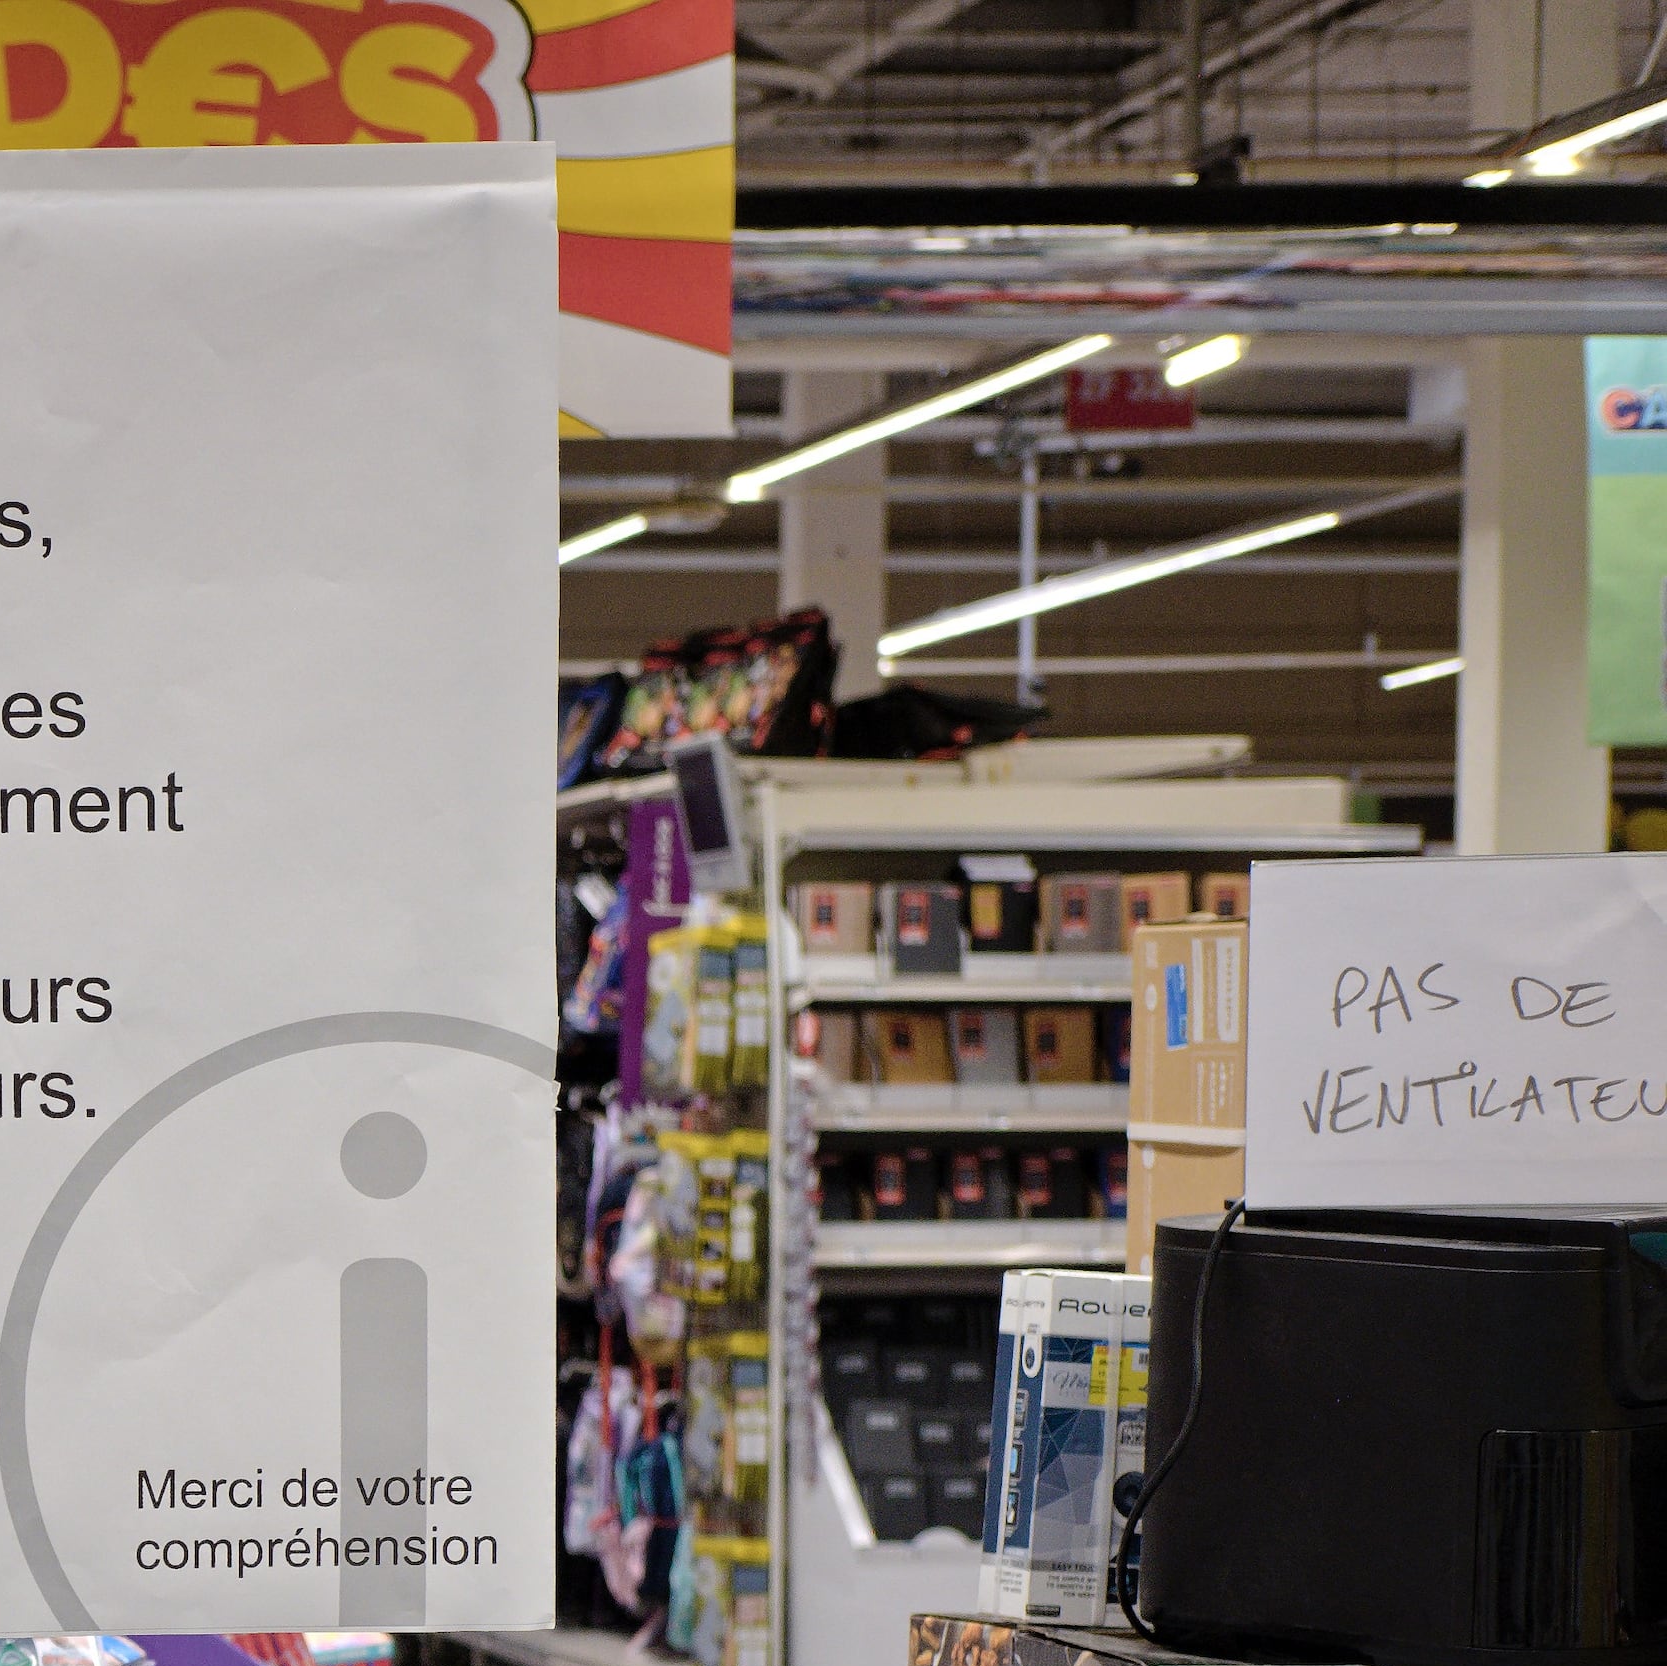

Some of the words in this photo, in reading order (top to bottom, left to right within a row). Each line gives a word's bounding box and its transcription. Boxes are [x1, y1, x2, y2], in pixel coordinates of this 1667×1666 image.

[1335, 963, 1460, 1034] PAS
[1511, 975, 1616, 1027] DE
[136, 1468, 264, 1512] Merci
[281, 1467, 339, 1507] de
[355, 1469, 473, 1506] votre
[134, 1527, 498, 1579] compréhension
